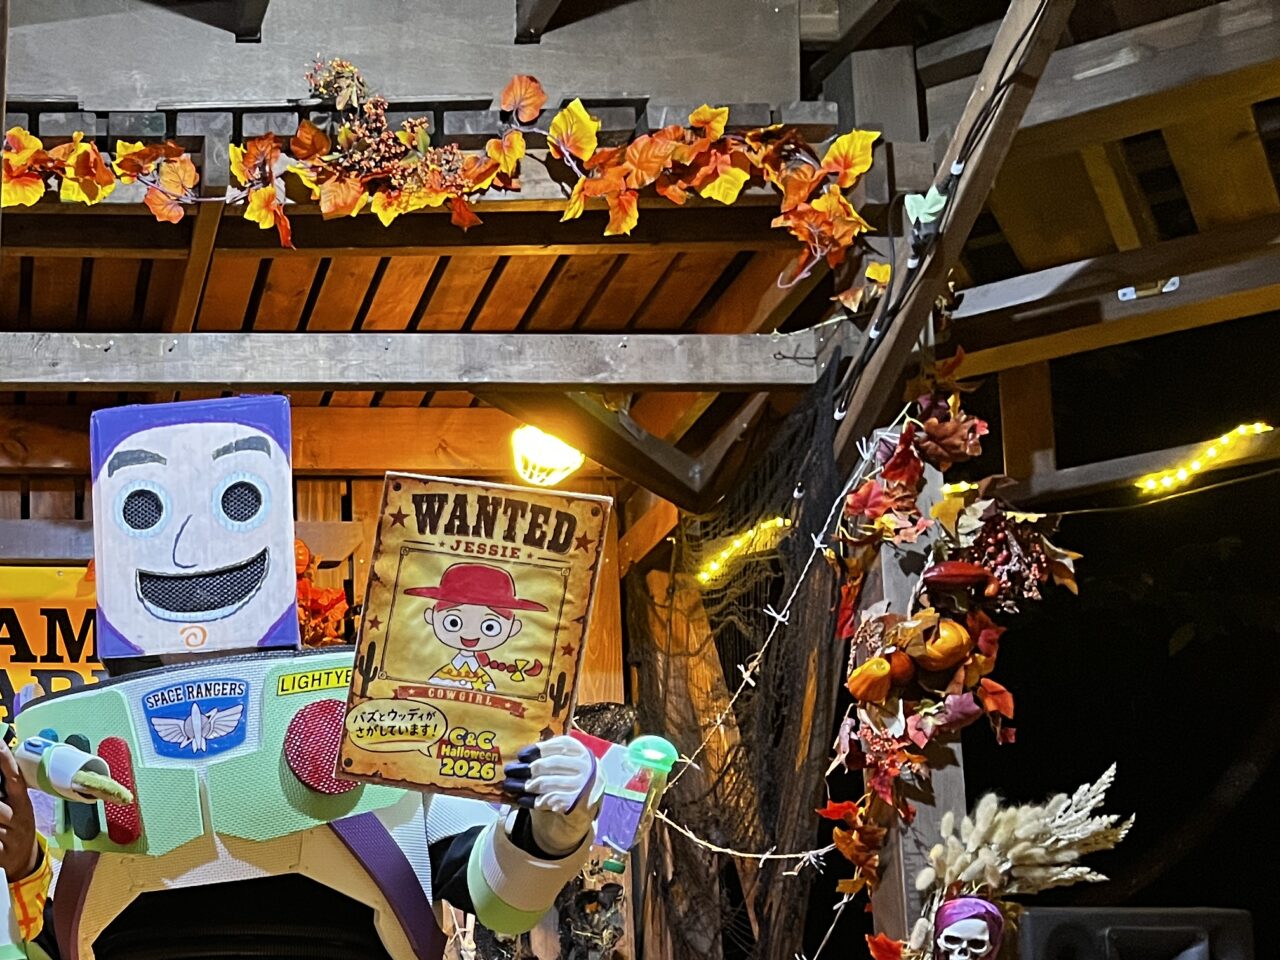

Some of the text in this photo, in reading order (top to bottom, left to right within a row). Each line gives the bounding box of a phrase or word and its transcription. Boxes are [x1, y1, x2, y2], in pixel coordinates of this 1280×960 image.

[412, 493, 577, 555] WANTED
[450, 540, 521, 559] JESSIE
[146, 682, 245, 709] SPACE RANGERS
[428, 688, 492, 705] COWGIRL
[353, 708, 437, 723] バズとウッディが
[448, 727, 496, 750] C&C
[440, 744, 500, 762] Halloween
[440, 757, 496, 781] 2026
